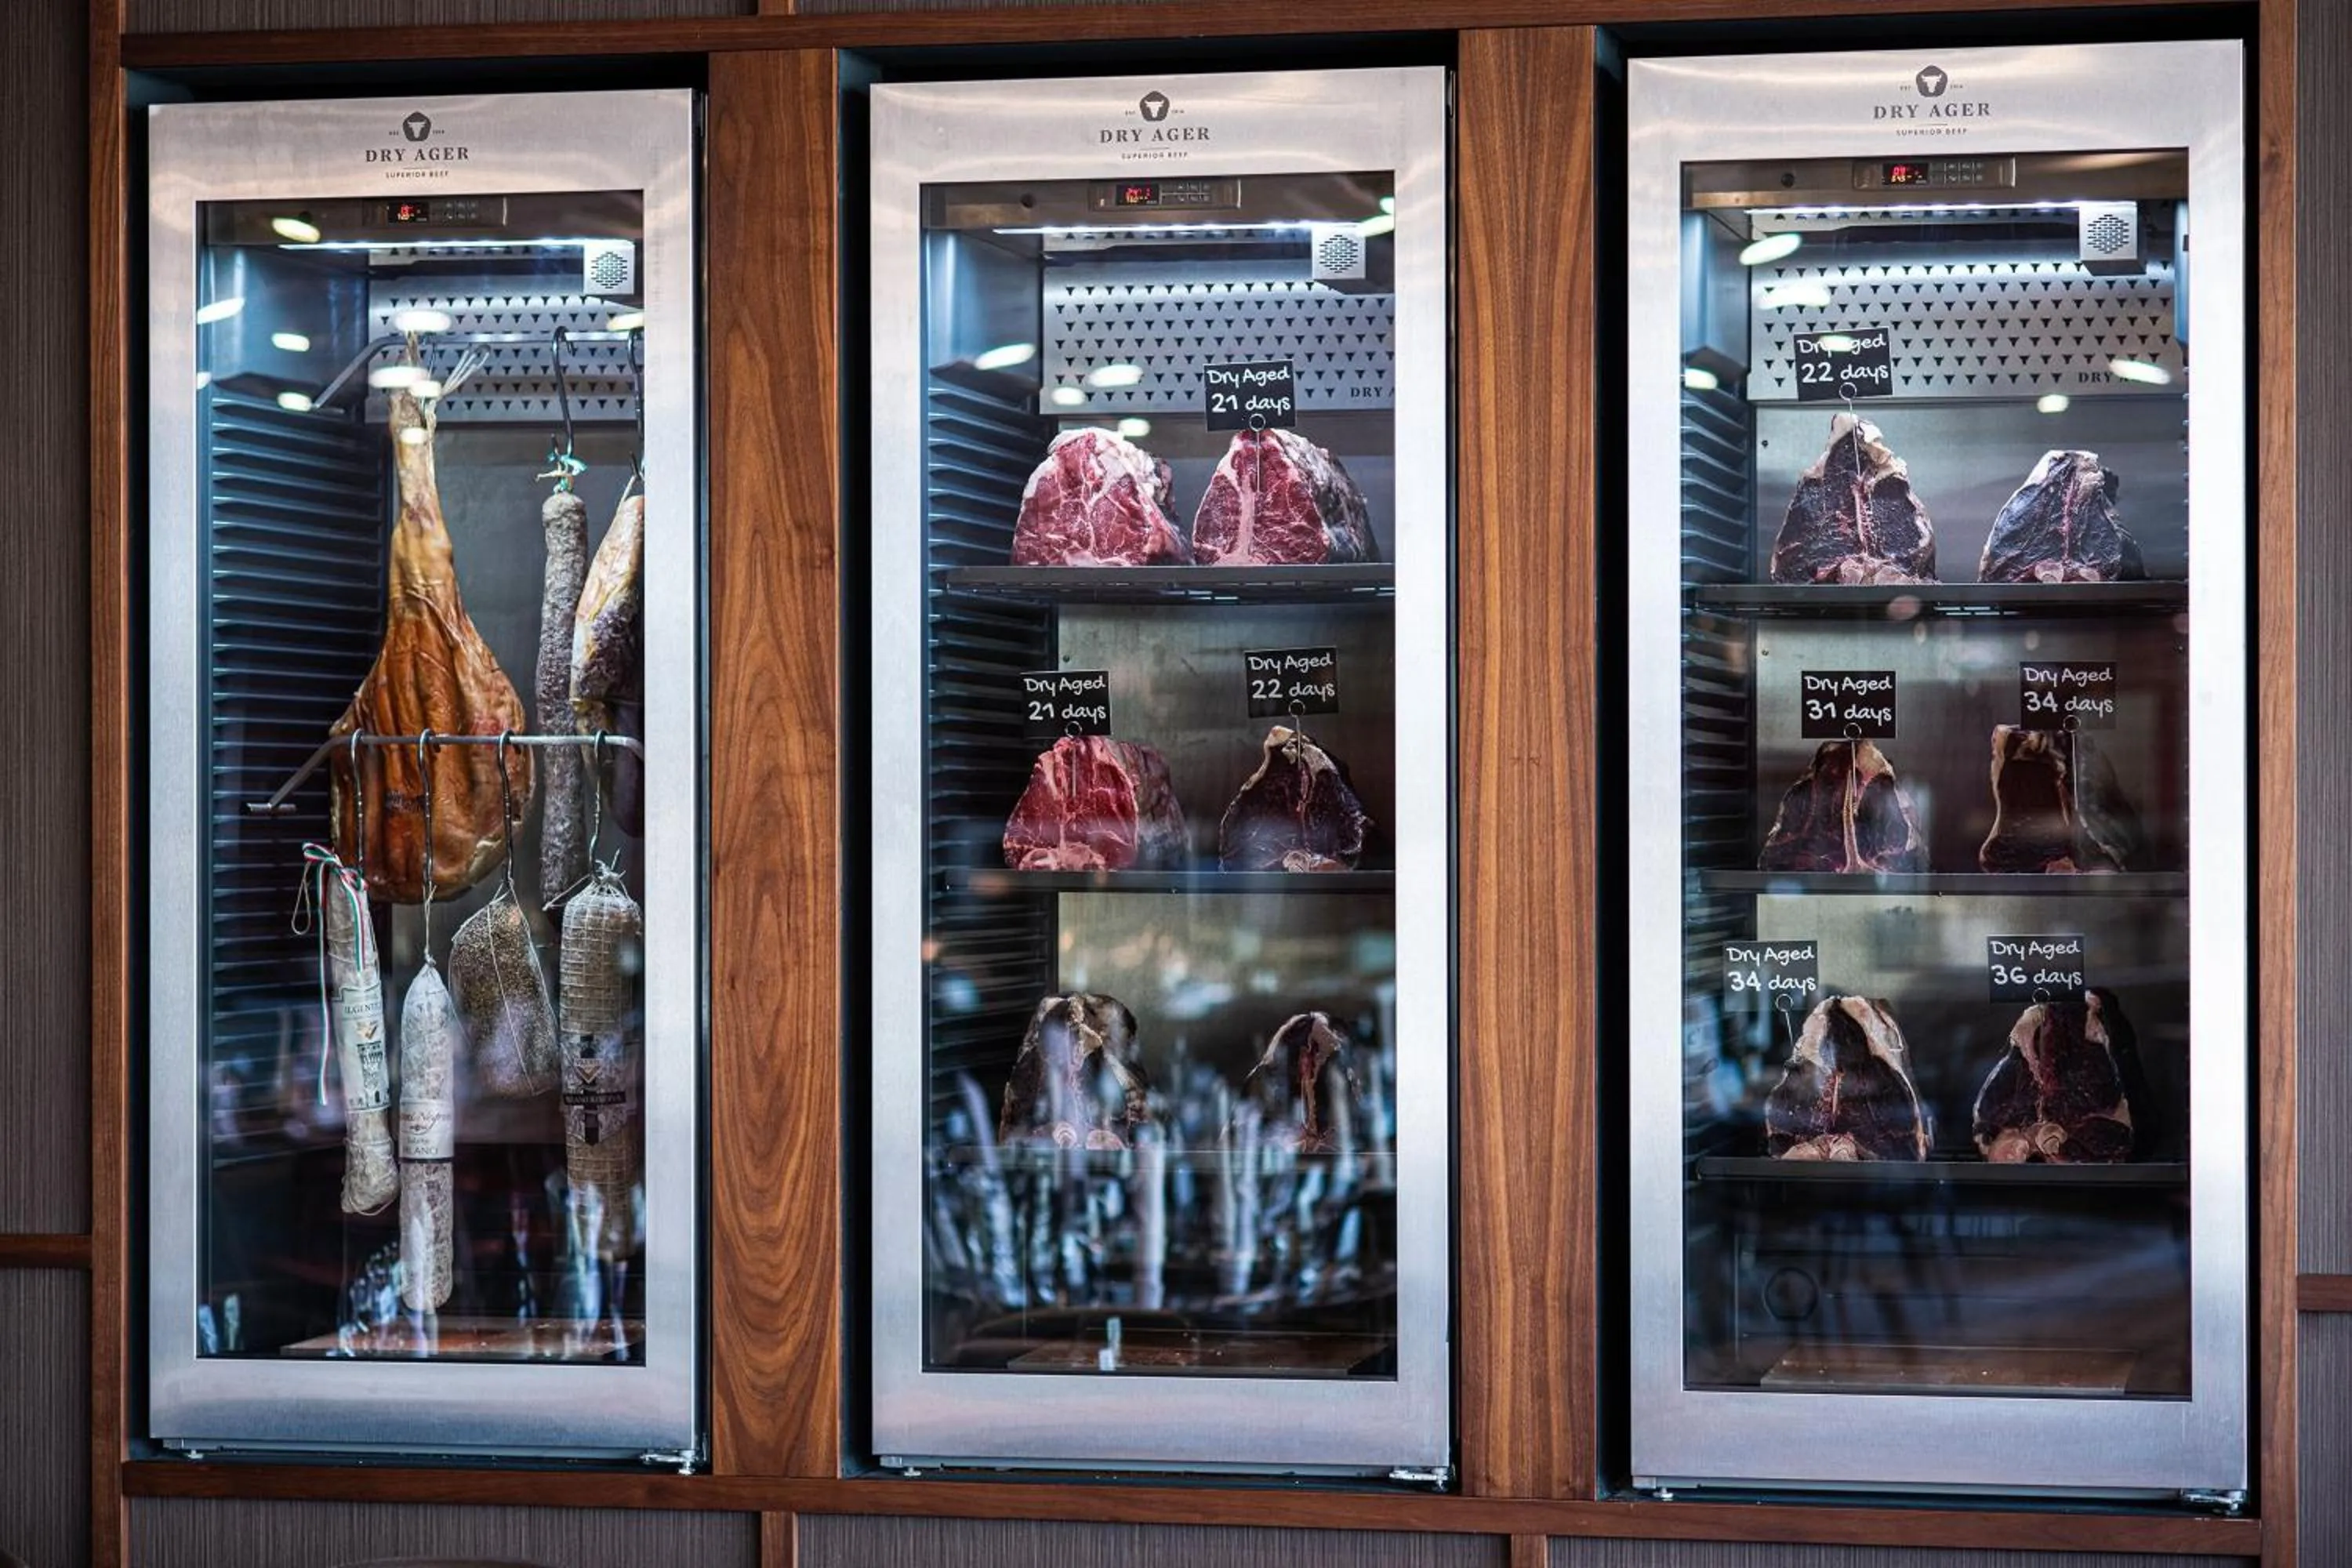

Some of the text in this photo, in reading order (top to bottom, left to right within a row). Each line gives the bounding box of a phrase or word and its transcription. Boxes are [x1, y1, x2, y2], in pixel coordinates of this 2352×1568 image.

[1874, 103, 1991, 118] DRY AGER
[1100, 127, 1210, 143] DRY AGER
[365, 147, 469, 162] DRY AGER
[1842, 333, 1886, 355] ged
[1206, 365, 1291, 388] Dry Aged
[1801, 361, 1889, 385] 22 days
[2078, 372, 2113, 383] DRY
[1350, 387, 1383, 397] DRY
[1211, 393, 1291, 416] 21 days
[1247, 652, 1334, 675] Dry Aged
[1023, 675, 1106, 697] Dry Aged
[1804, 676, 1893, 697] Dry Aged
[2023, 667, 2113, 688] Dry Aged
[1251, 678, 1335, 702] 22 days
[1029, 701, 1106, 725] 21 days
[1806, 699, 1892, 727] 31 days
[2024, 691, 2114, 719] 34 days
[1726, 946, 1815, 967] Dry Aged
[1990, 940, 2082, 960] Dry Aged
[1727, 971, 1817, 996] 34 days
[1991, 964, 2083, 990] 36 days
